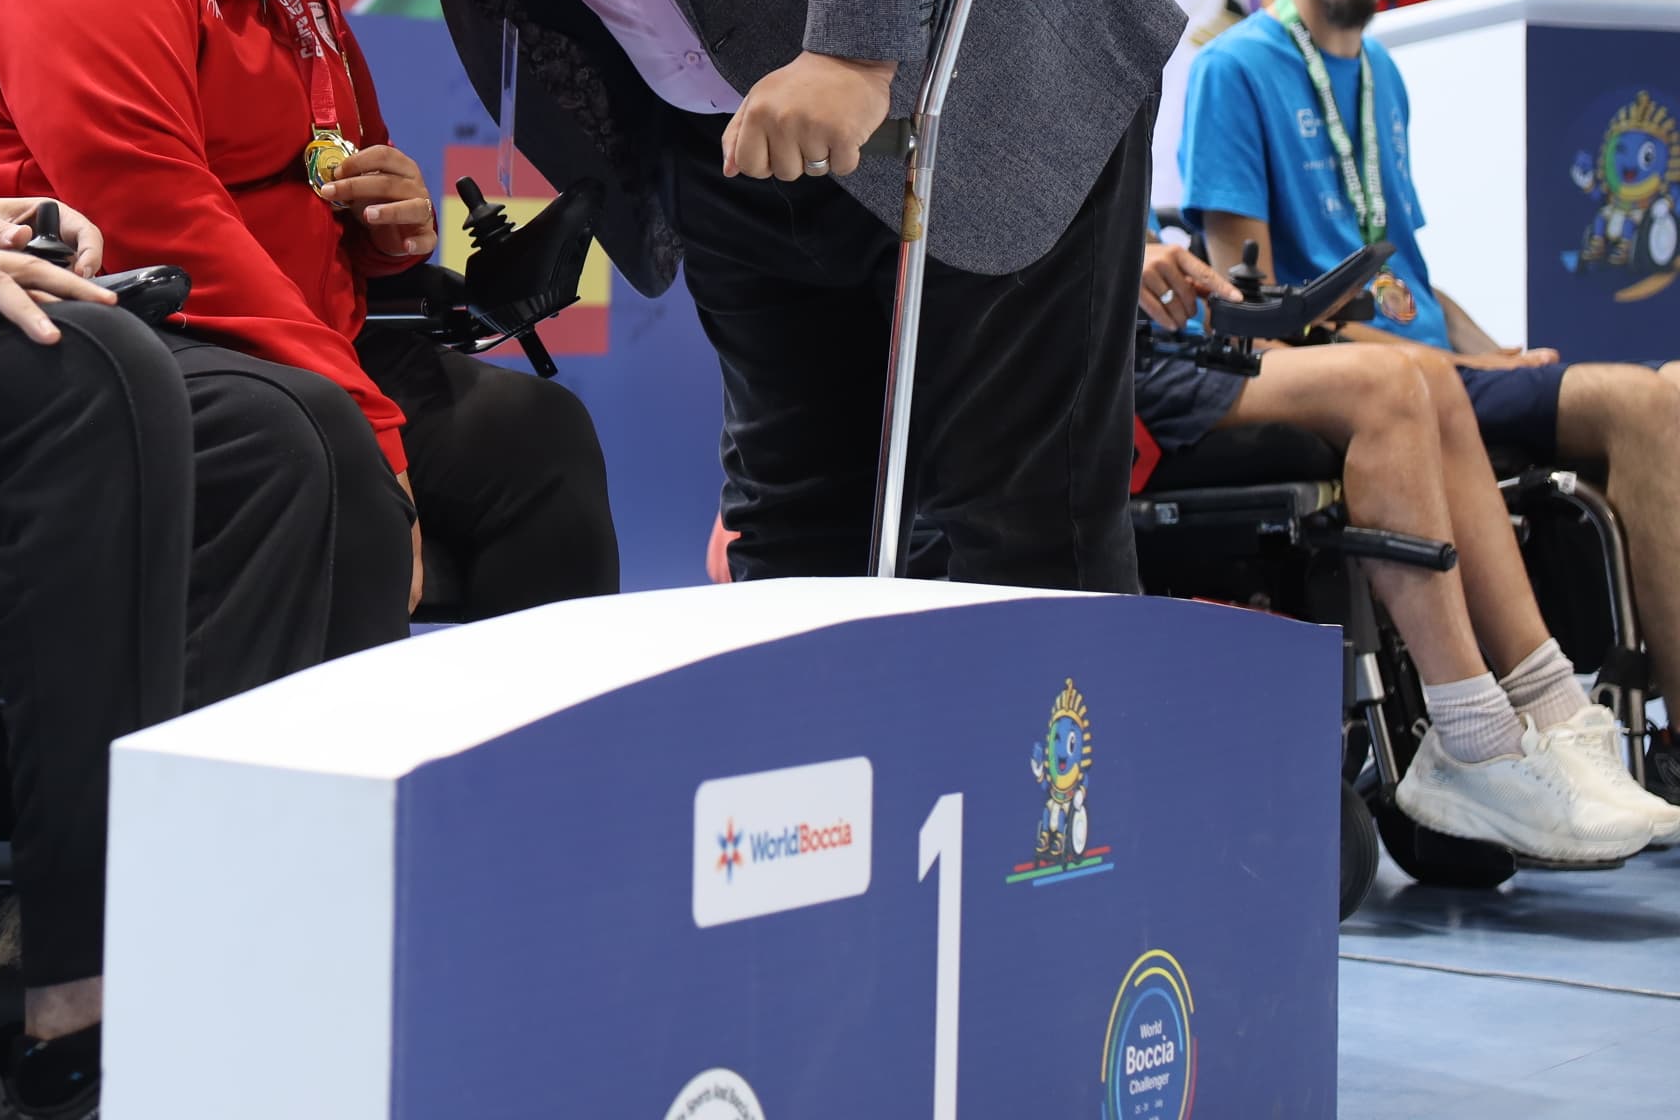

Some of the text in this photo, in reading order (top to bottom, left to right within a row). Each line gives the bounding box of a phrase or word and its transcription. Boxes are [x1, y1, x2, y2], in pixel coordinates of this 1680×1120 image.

[749, 818, 852, 863] WorldBoccia
[918, 791, 963, 1120] 1
[1140, 1019, 1163, 1039] World
[1125, 1034, 1175, 1075] Boccia
[1129, 1072, 1170, 1095] Challenger
